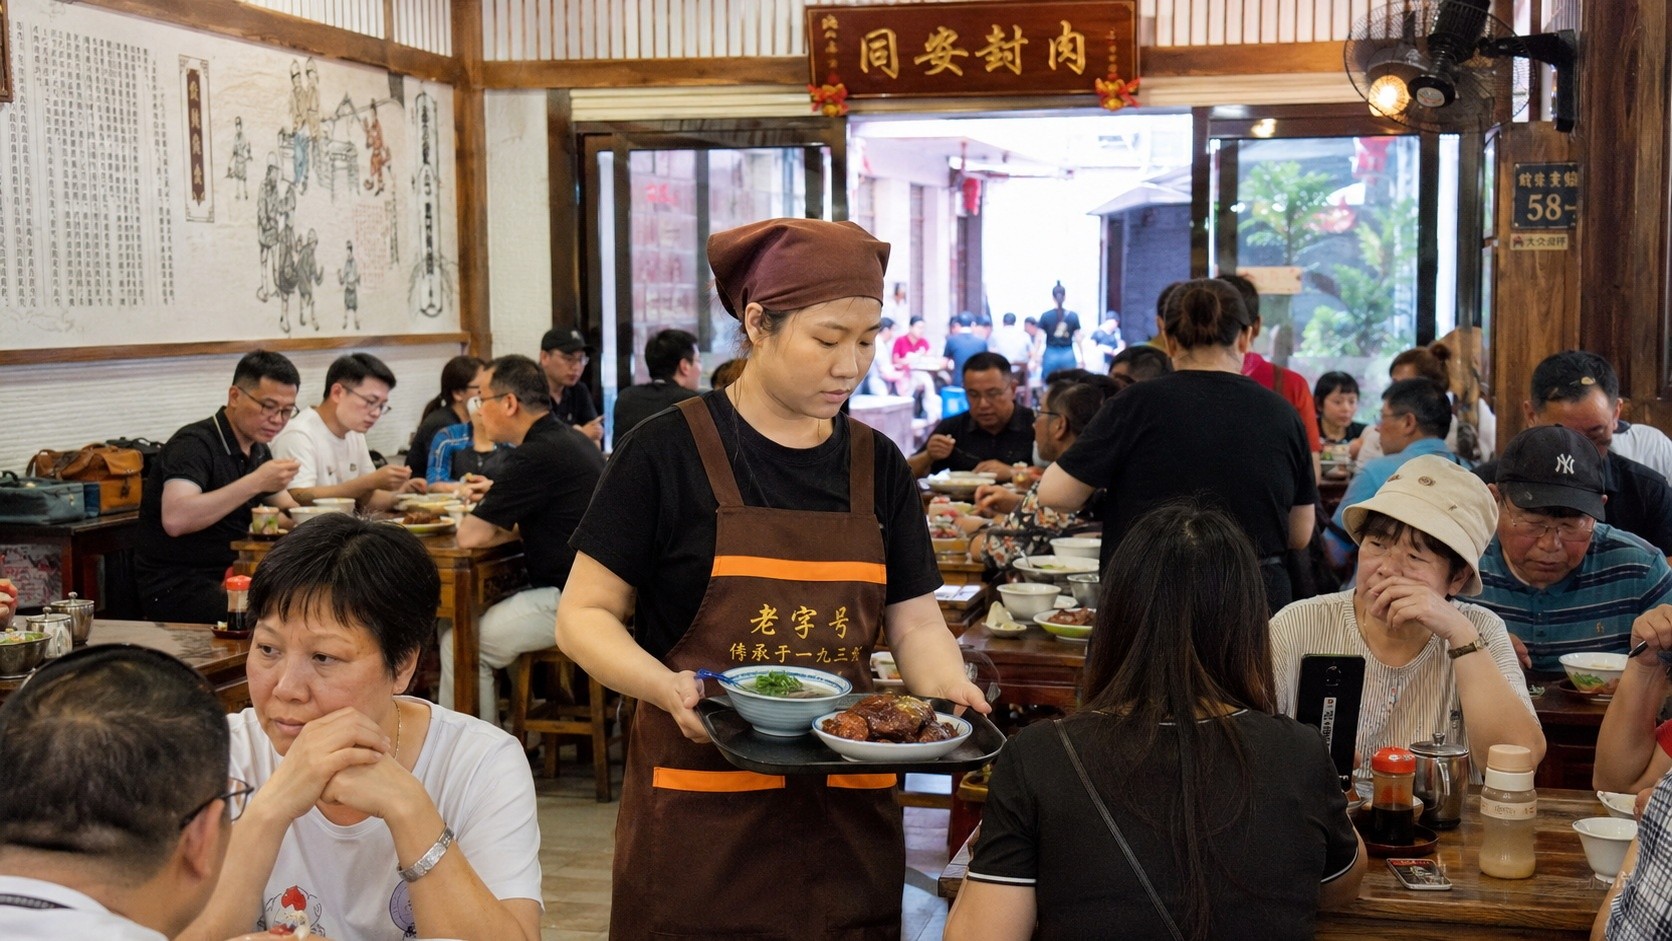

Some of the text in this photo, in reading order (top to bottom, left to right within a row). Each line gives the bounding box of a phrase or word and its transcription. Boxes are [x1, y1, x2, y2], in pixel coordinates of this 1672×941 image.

[859, 19, 1086, 80] 同安封肉
[1555, 453, 1575, 475] NY
[750, 603, 850, 640] 老字号
